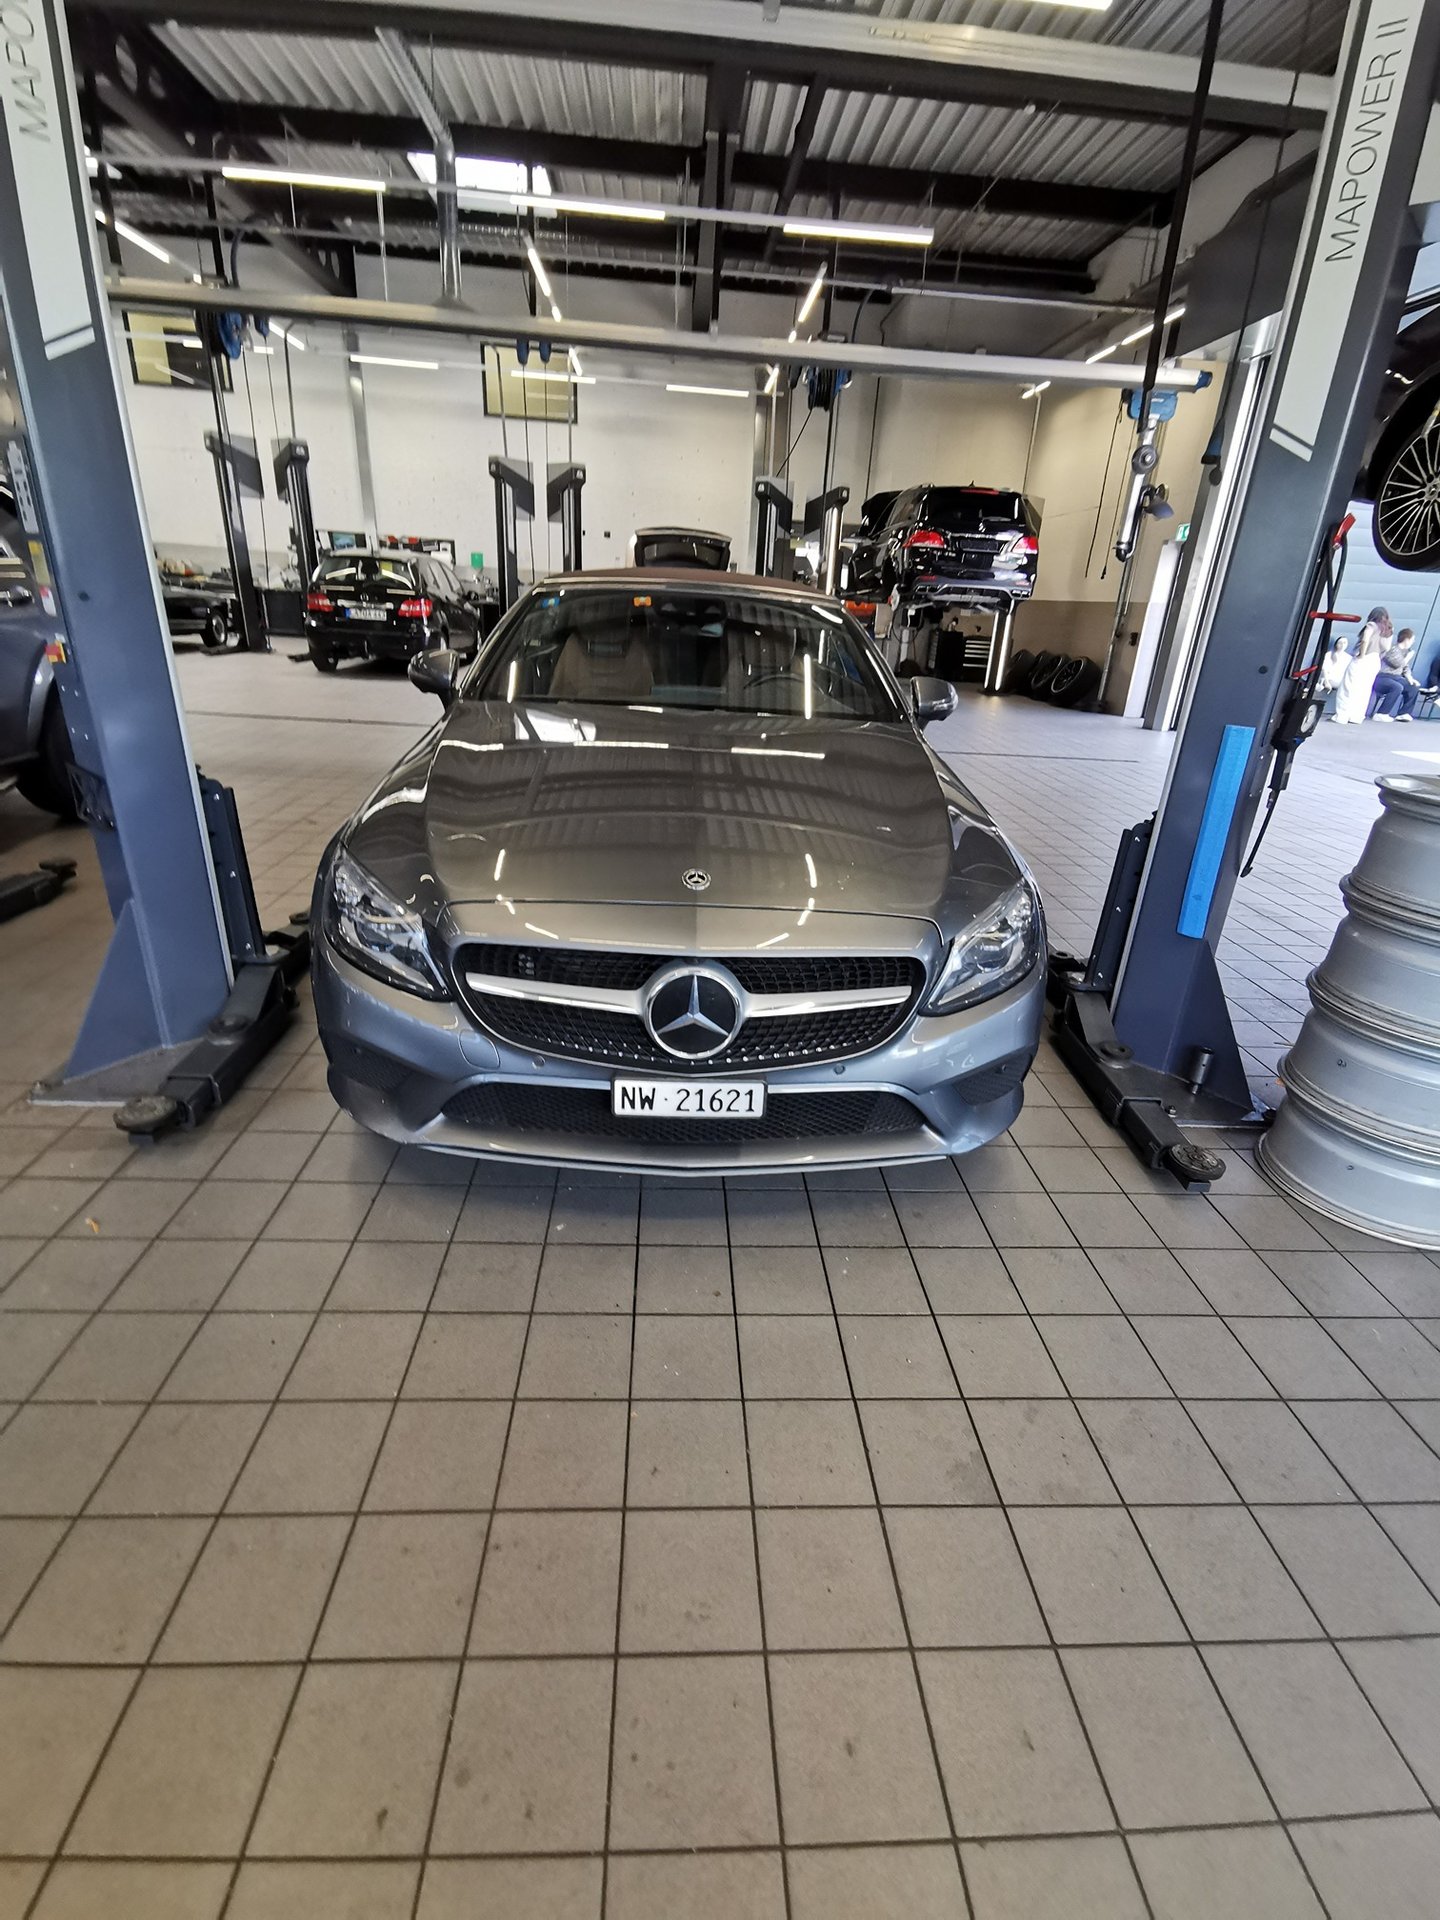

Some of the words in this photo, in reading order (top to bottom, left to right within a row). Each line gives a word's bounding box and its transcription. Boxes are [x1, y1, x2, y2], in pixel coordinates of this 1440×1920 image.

[1324, 48, 1402, 262] MAPOWER
[1375, 17, 1409, 40] II
[676, 1088, 755, 1112] 21621
